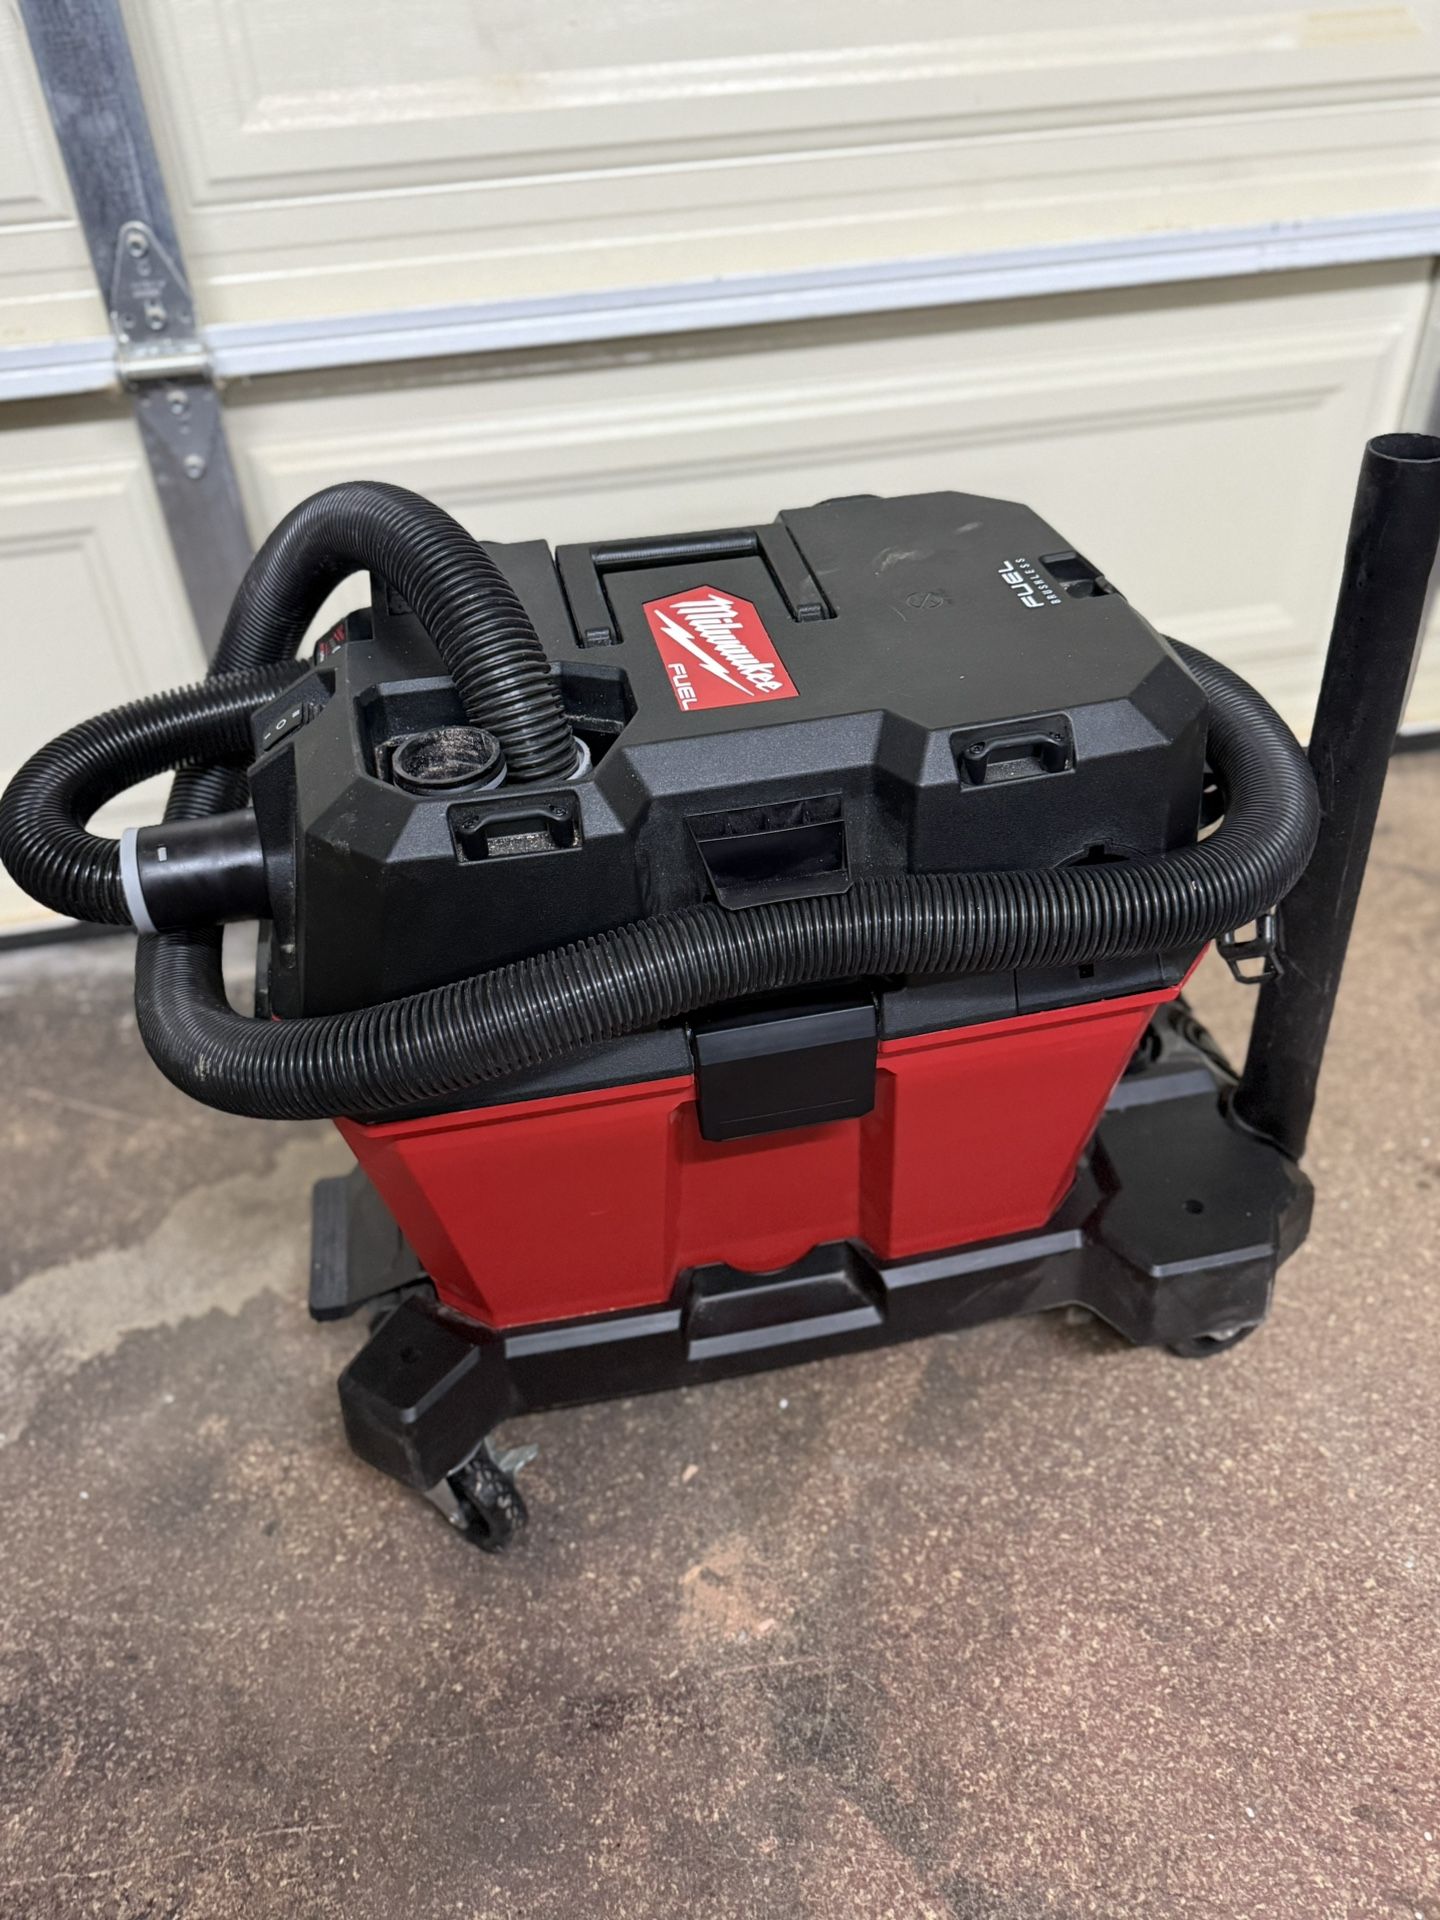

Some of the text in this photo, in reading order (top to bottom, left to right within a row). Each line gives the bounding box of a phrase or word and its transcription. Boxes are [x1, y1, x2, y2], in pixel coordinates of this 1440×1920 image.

[998, 560, 1045, 608] FUEL
[1015, 558, 1061, 604] BRUSHLESS
[669, 594, 783, 693] Milwaukee
[667, 662, 698, 711] FUEL
